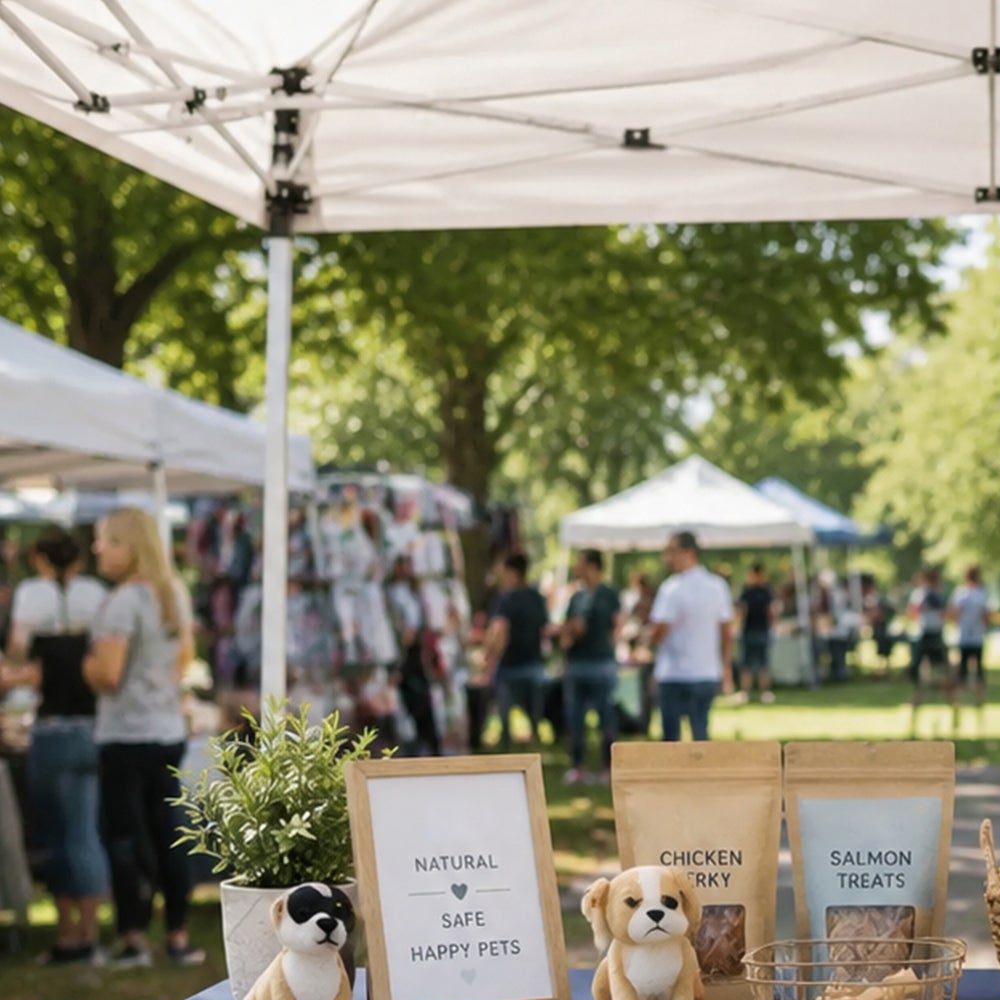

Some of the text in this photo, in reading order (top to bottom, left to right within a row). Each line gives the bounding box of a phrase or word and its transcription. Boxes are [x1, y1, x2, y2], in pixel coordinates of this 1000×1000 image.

[414, 854, 499, 872] NATURAL
[659, 849, 743, 866] CHICKEN
[830, 850, 912, 867] SALMON
[687, 871, 732, 888] RKY
[837, 872, 906, 889] TREATS
[441, 911, 486, 929] SAFE
[410, 939, 522, 962] HAPPY PETS
